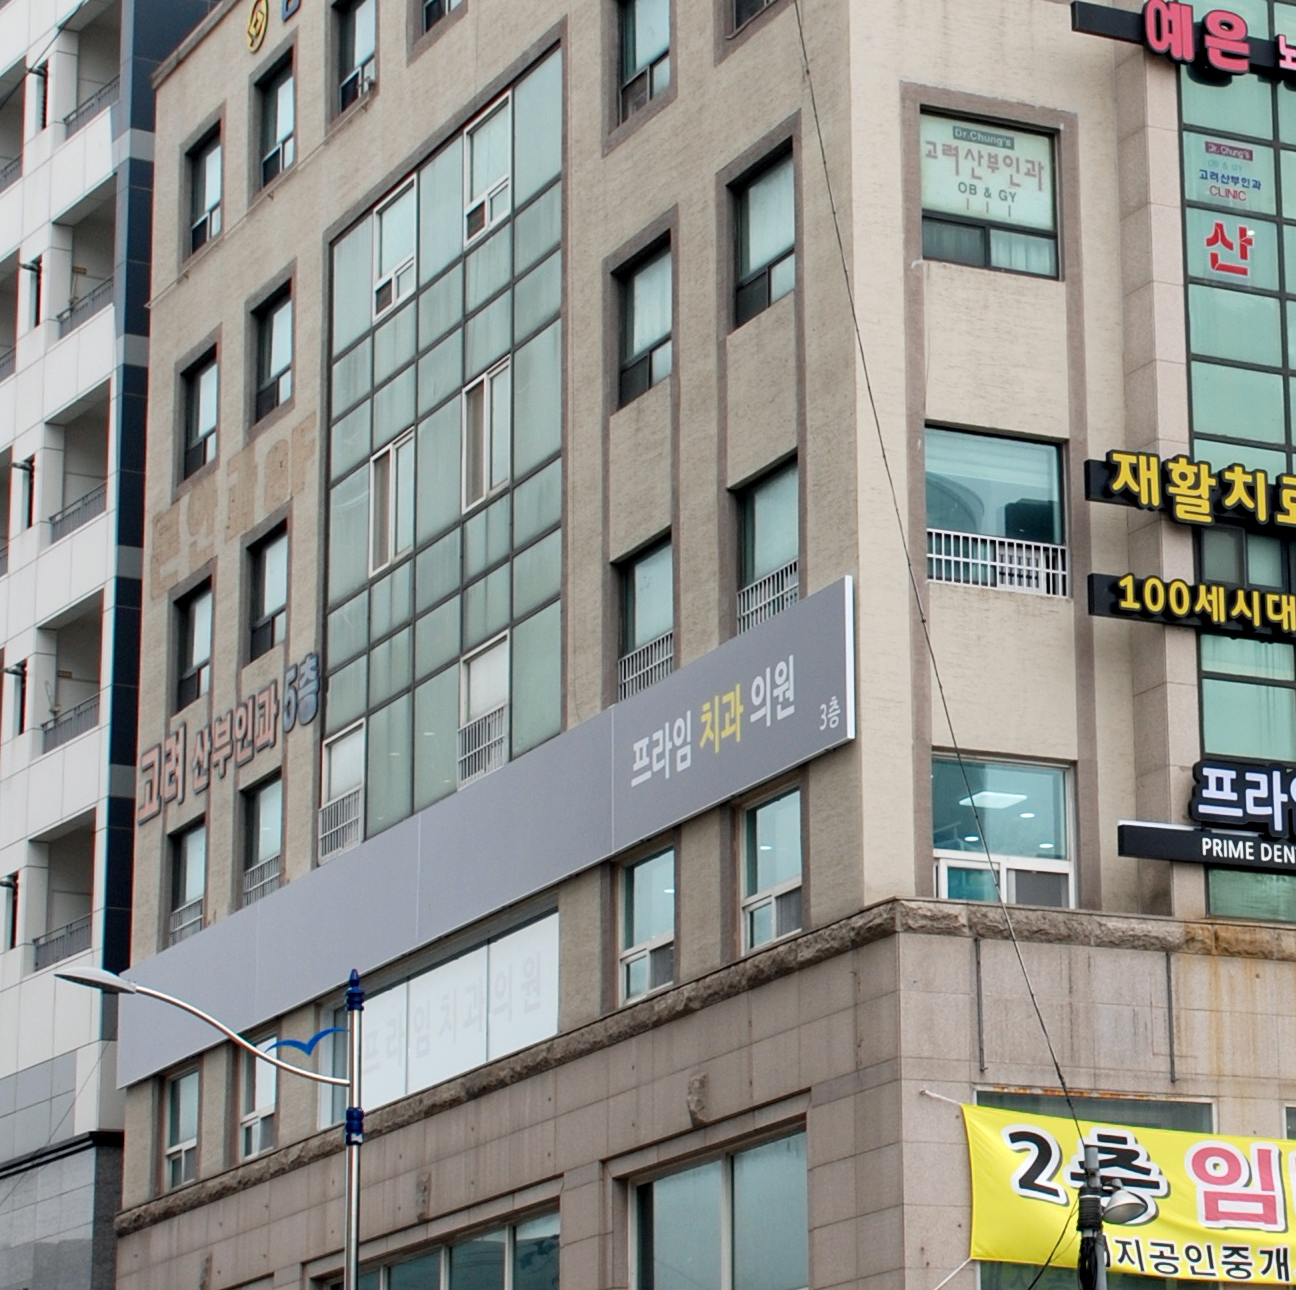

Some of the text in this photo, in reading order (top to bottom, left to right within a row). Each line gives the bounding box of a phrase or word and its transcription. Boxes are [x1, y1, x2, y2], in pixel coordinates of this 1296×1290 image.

[925, 141, 1044, 191] 고려산부인과
[1199, 169, 1261, 191] 고려산부인과
[957, 182, 978, 197] OB
[998, 189, 1017, 203] GY
[1209, 185, 1247, 201] CLINIC
[1118, 574, 1296, 632] 100세시대
[136, 651, 321, 825] 고려 산부인과 5층
[631, 654, 841, 787] 프라임 치과 의원 3층
[1201, 837, 1255, 861] PRIME
